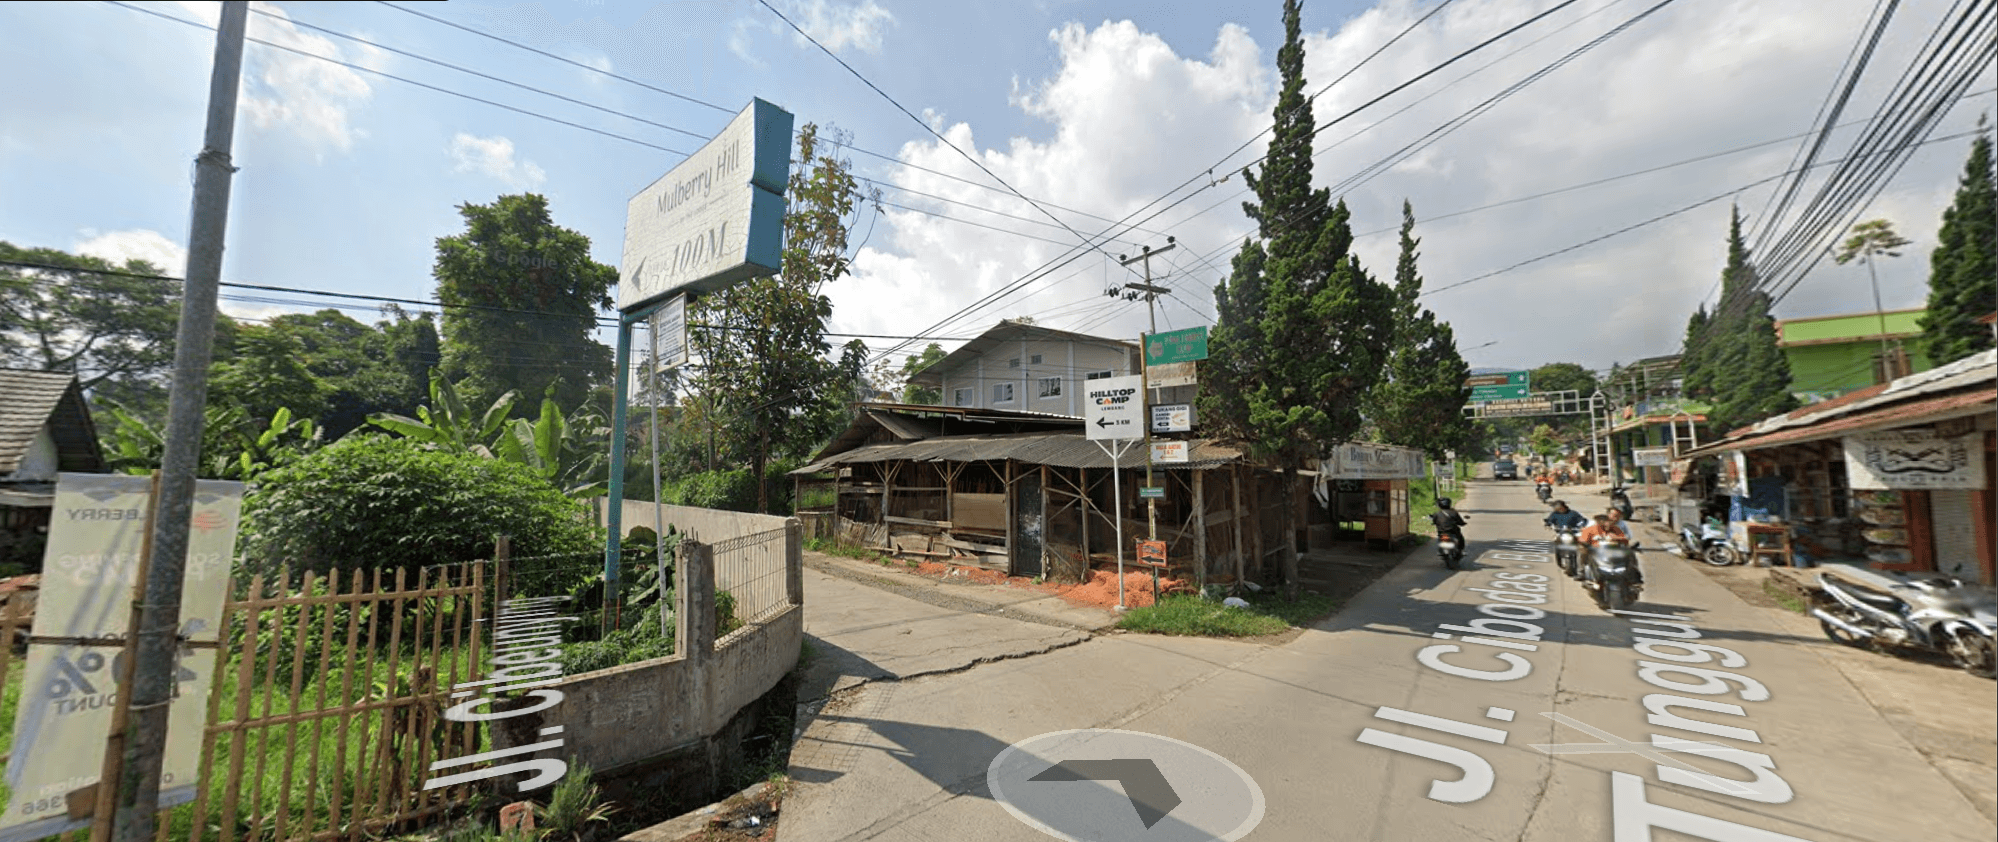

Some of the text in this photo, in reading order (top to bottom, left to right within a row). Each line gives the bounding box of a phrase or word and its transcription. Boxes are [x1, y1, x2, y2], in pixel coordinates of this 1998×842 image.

[658, 167, 712, 218] Mulberry
[716, 139, 739, 182] Hill
[671, 221, 728, 276] 100M
[1090, 388, 1136, 398] HILLTOP
